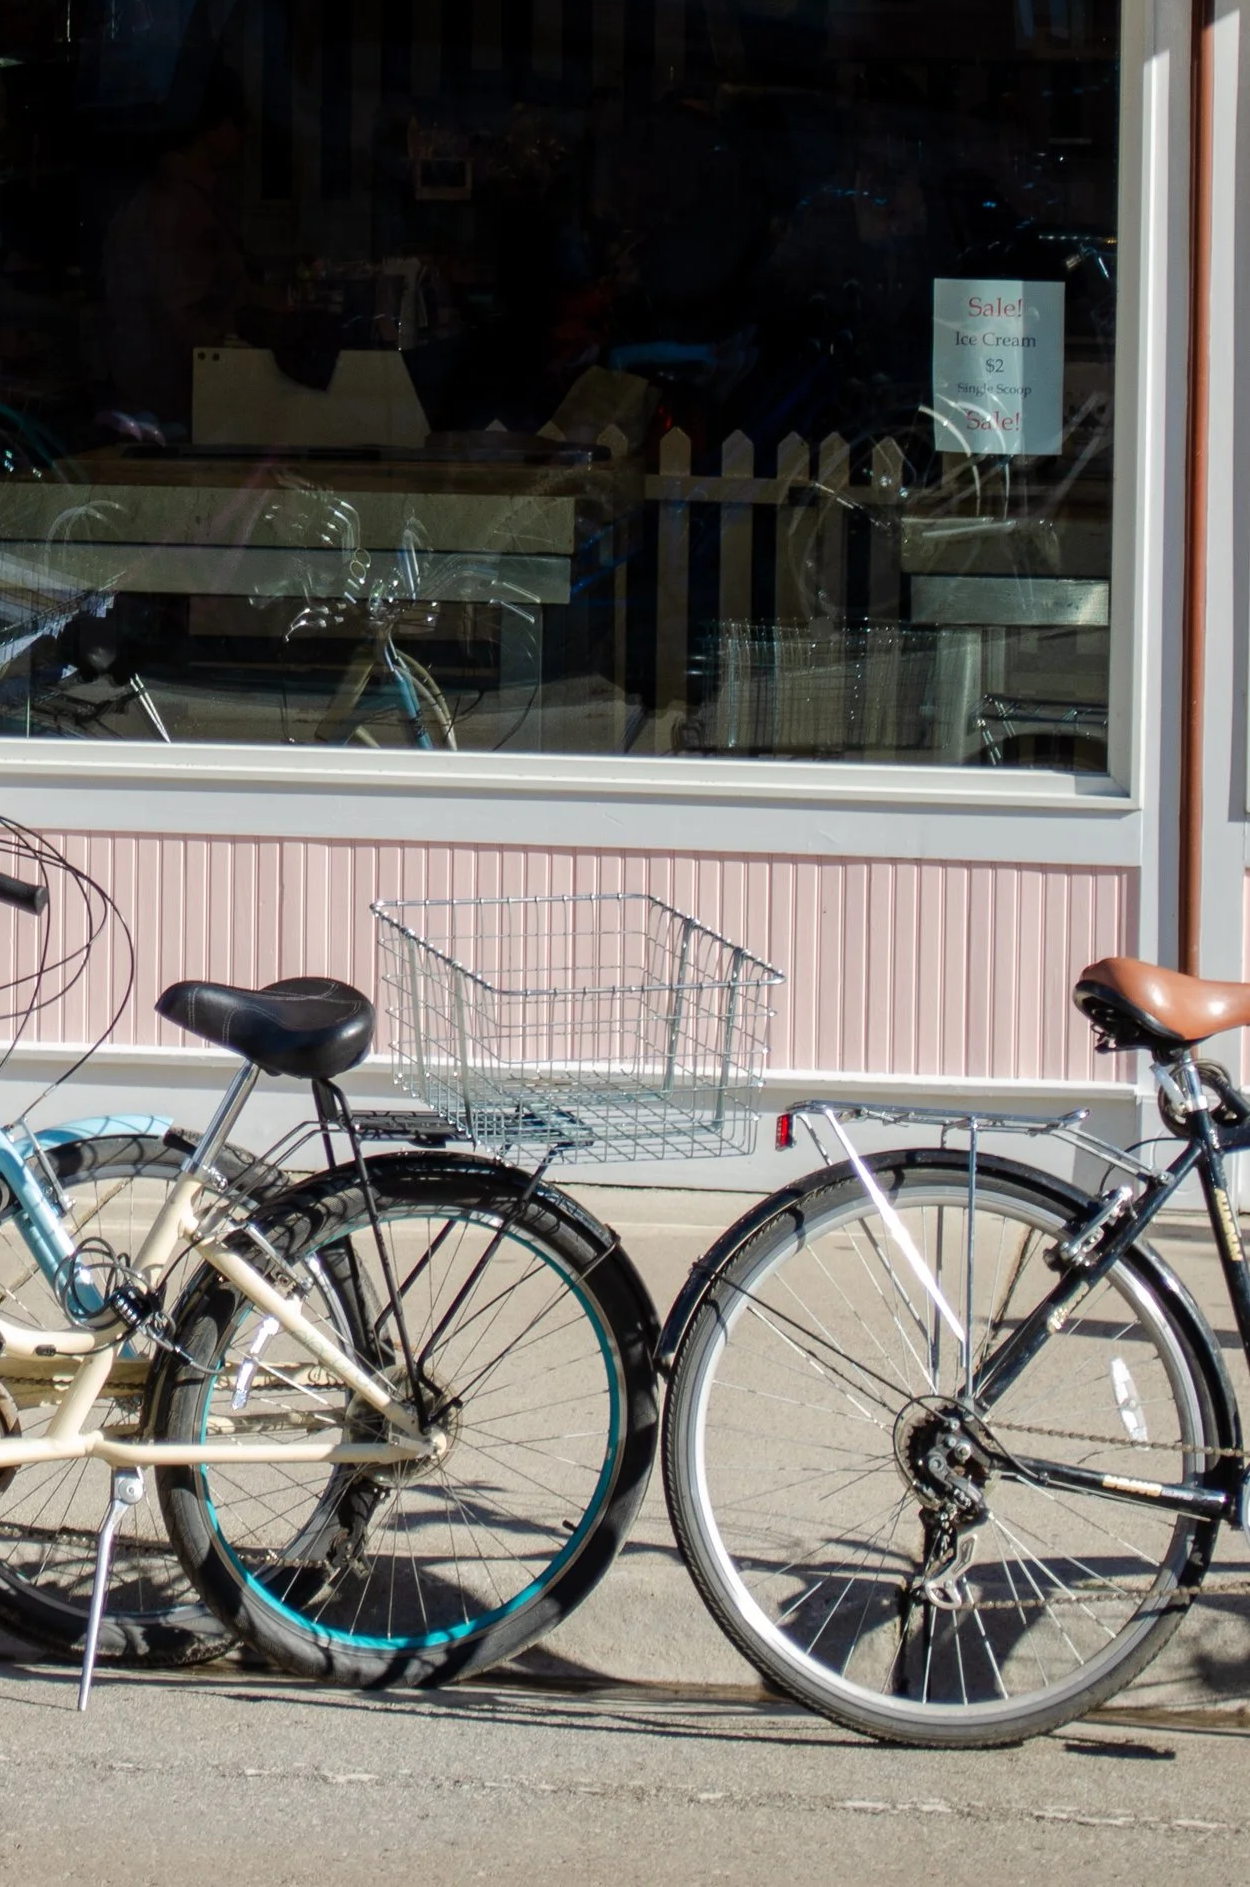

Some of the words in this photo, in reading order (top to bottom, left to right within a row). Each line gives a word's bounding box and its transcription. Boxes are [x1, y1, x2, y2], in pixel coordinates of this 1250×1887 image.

[968, 297, 1023, 318] Sale!
[955, 331, 978, 347] Ice
[982, 331, 1037, 348] Cream
[985, 358, 1004, 375] $2
[957, 382, 993, 398] Single
[996, 384, 1033, 398] Scoop
[966, 411, 1021, 431] Sale!
